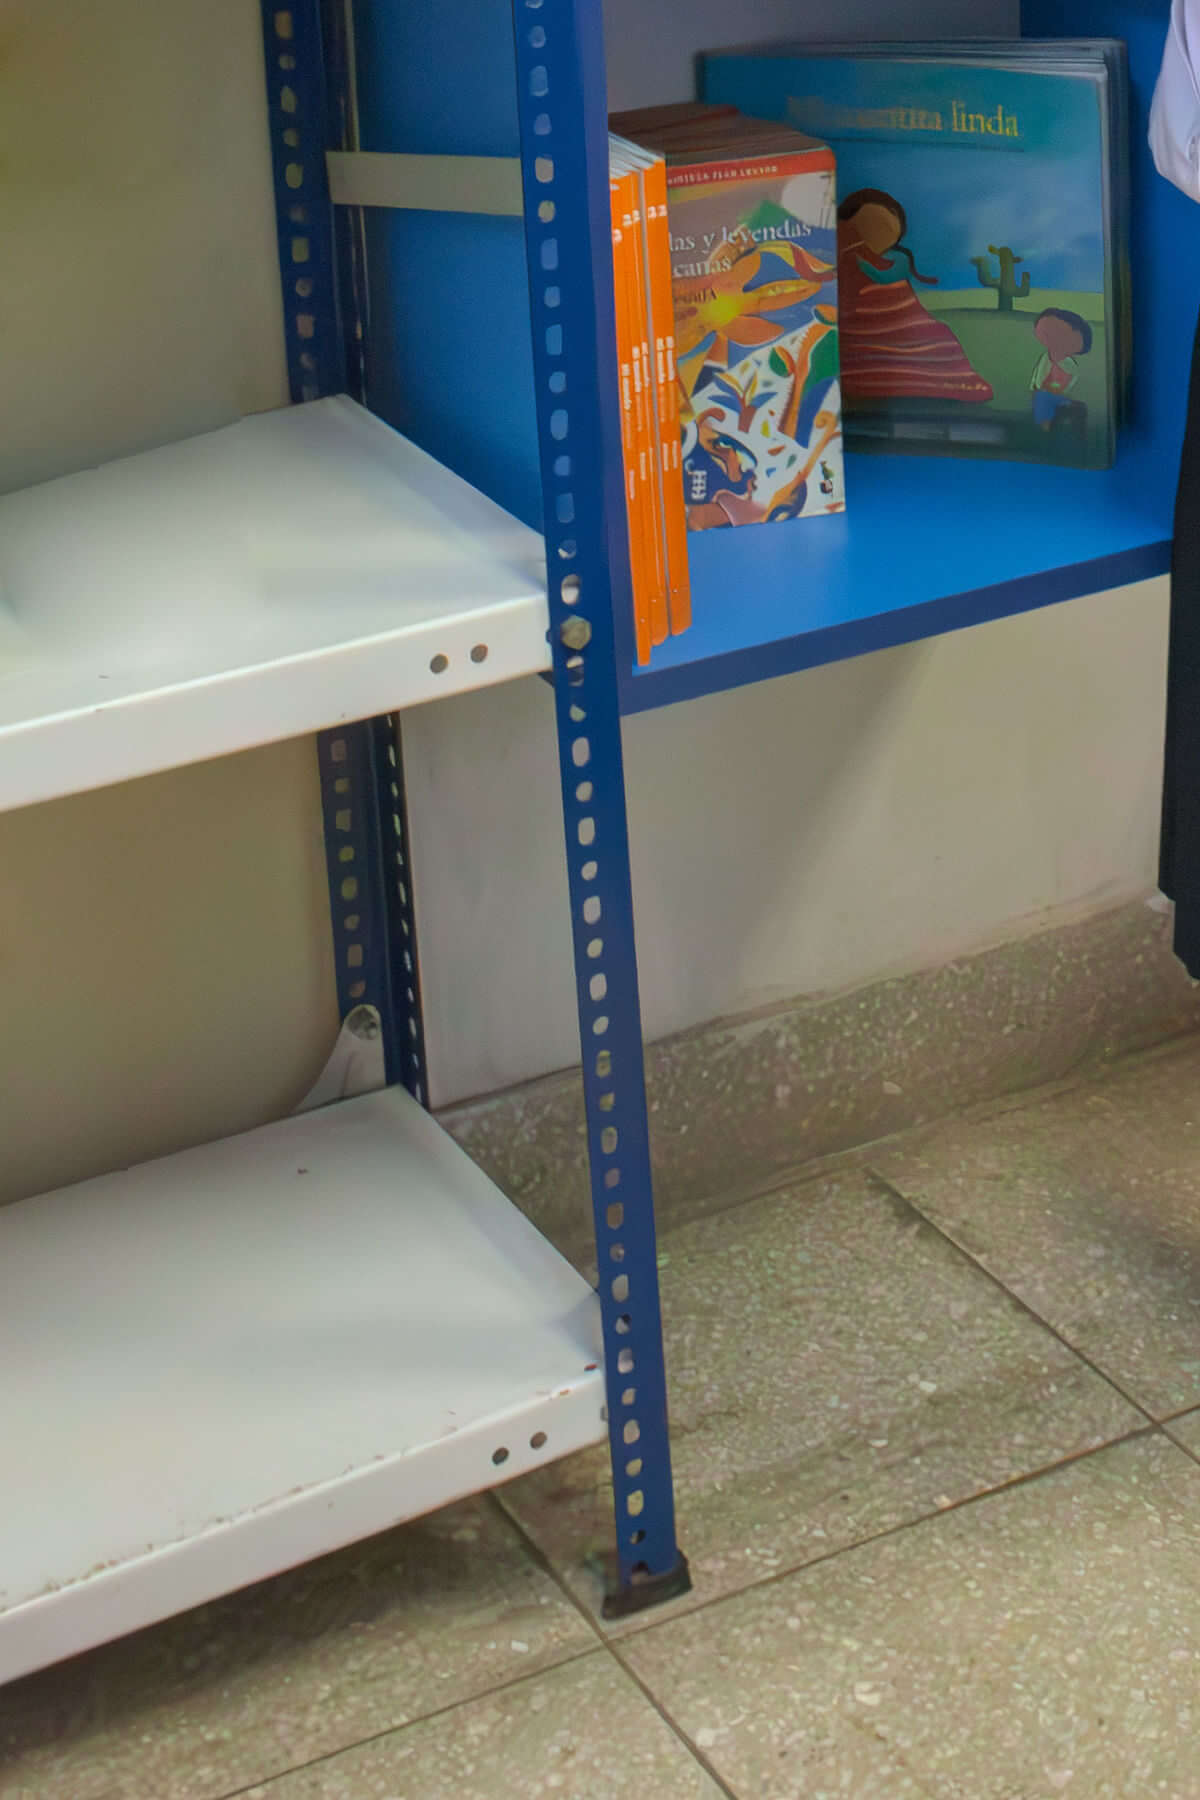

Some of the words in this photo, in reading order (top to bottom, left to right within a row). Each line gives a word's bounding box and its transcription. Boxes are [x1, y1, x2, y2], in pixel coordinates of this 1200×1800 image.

[952, 98, 1019, 137] linda
[704, 232, 716, 254] y
[722, 218, 812, 253] leyendas
